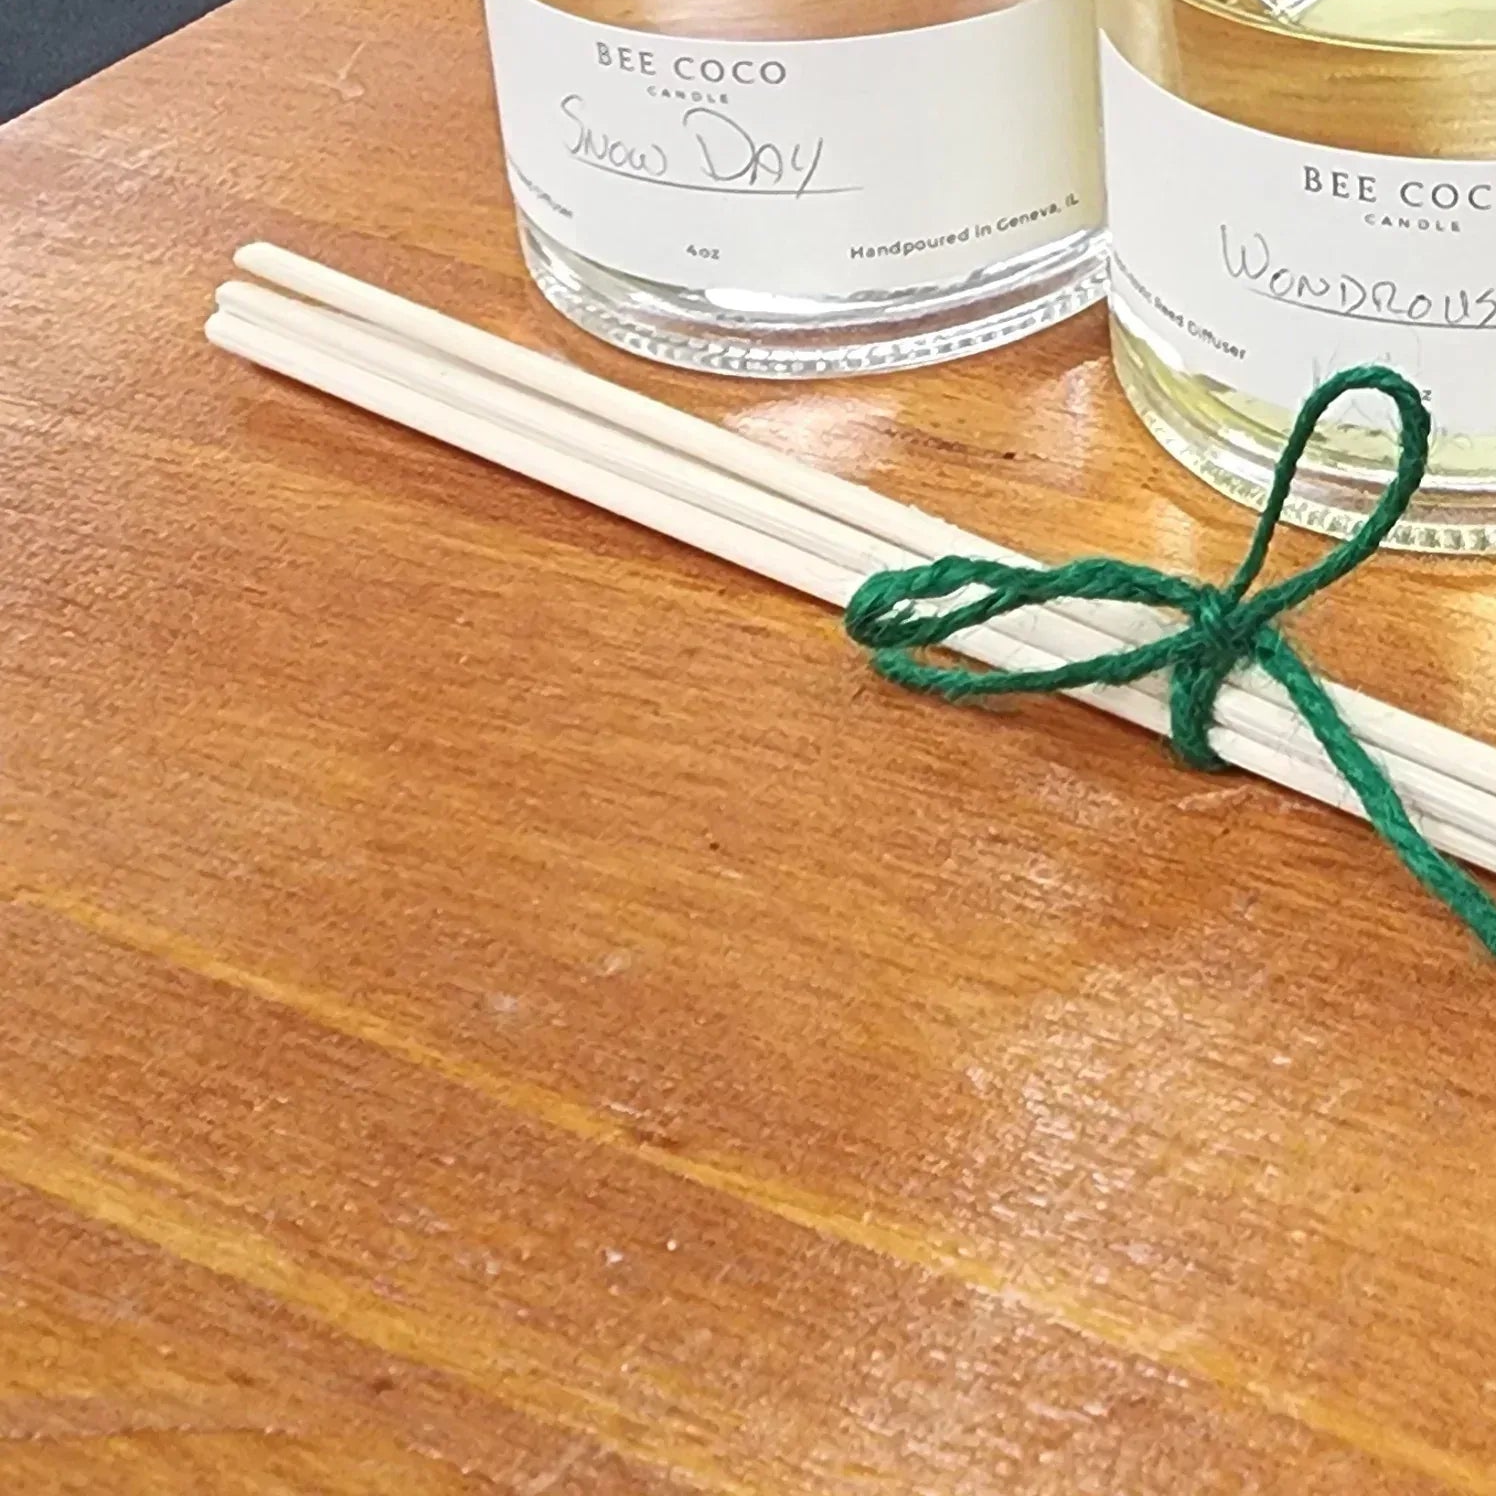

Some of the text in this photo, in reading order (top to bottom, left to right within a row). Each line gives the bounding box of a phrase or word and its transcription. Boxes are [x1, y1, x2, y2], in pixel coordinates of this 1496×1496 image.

[596, 41, 787, 85] BEE COCO
[646, 85, 729, 105] CANDLE
[1303, 165, 1378, 204] BEE
[1363, 212, 1462, 233] CANDLE
[686, 243, 721, 261] 4oz
[850, 228, 970, 260] Handpoured
[975, 223, 992, 238] in
